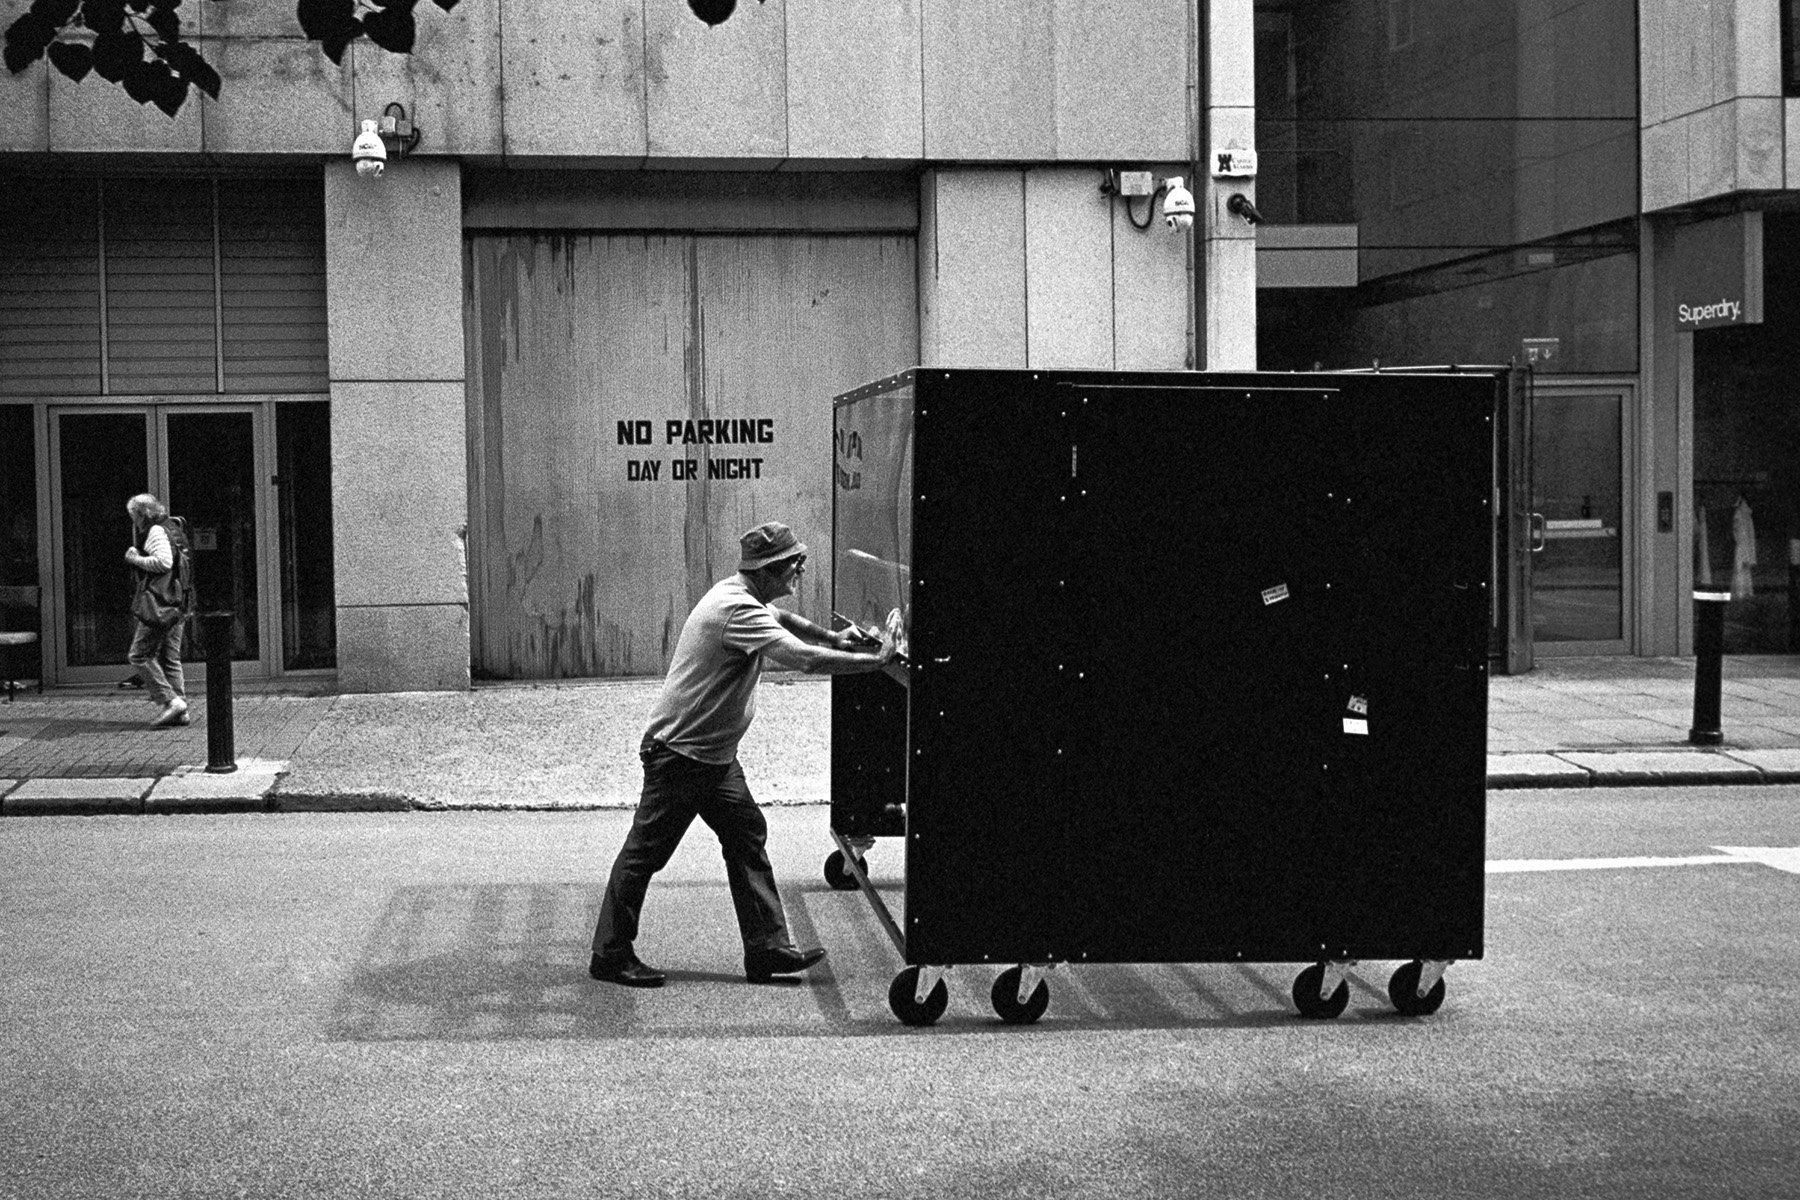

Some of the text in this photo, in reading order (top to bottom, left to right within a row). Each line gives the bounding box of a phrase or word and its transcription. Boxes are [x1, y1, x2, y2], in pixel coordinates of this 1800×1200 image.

[1679, 298, 1741, 325] Superdry.
[617, 419, 774, 445] NO PARKING
[627, 458, 764, 481] DAY OR NIGHT
